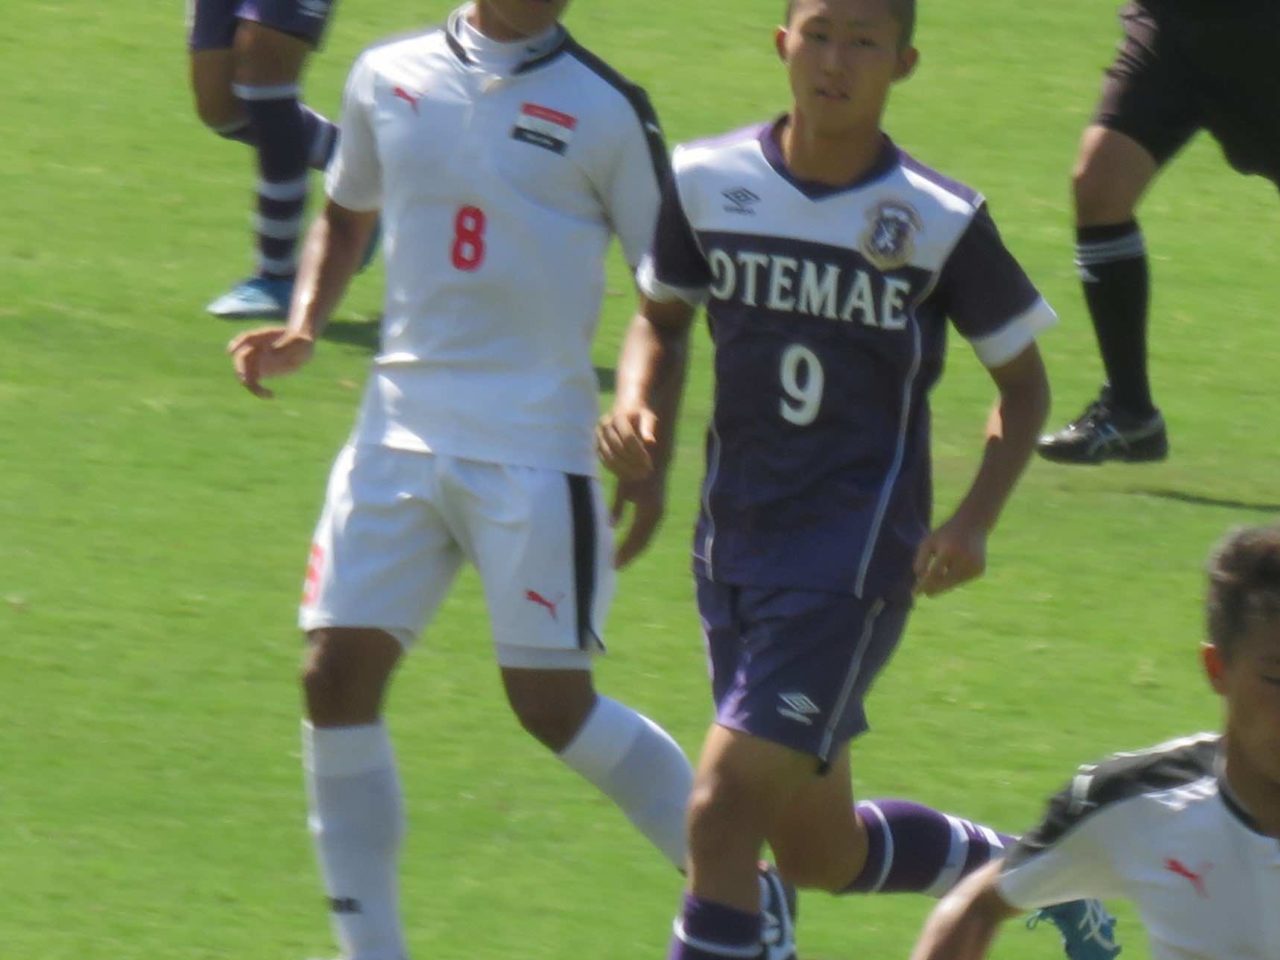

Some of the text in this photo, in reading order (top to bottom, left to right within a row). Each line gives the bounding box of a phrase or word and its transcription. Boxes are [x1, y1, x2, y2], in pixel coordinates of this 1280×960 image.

[452, 206, 486, 272] 8
[709, 248, 911, 330] OTEMAE
[779, 343, 825, 426] 9
